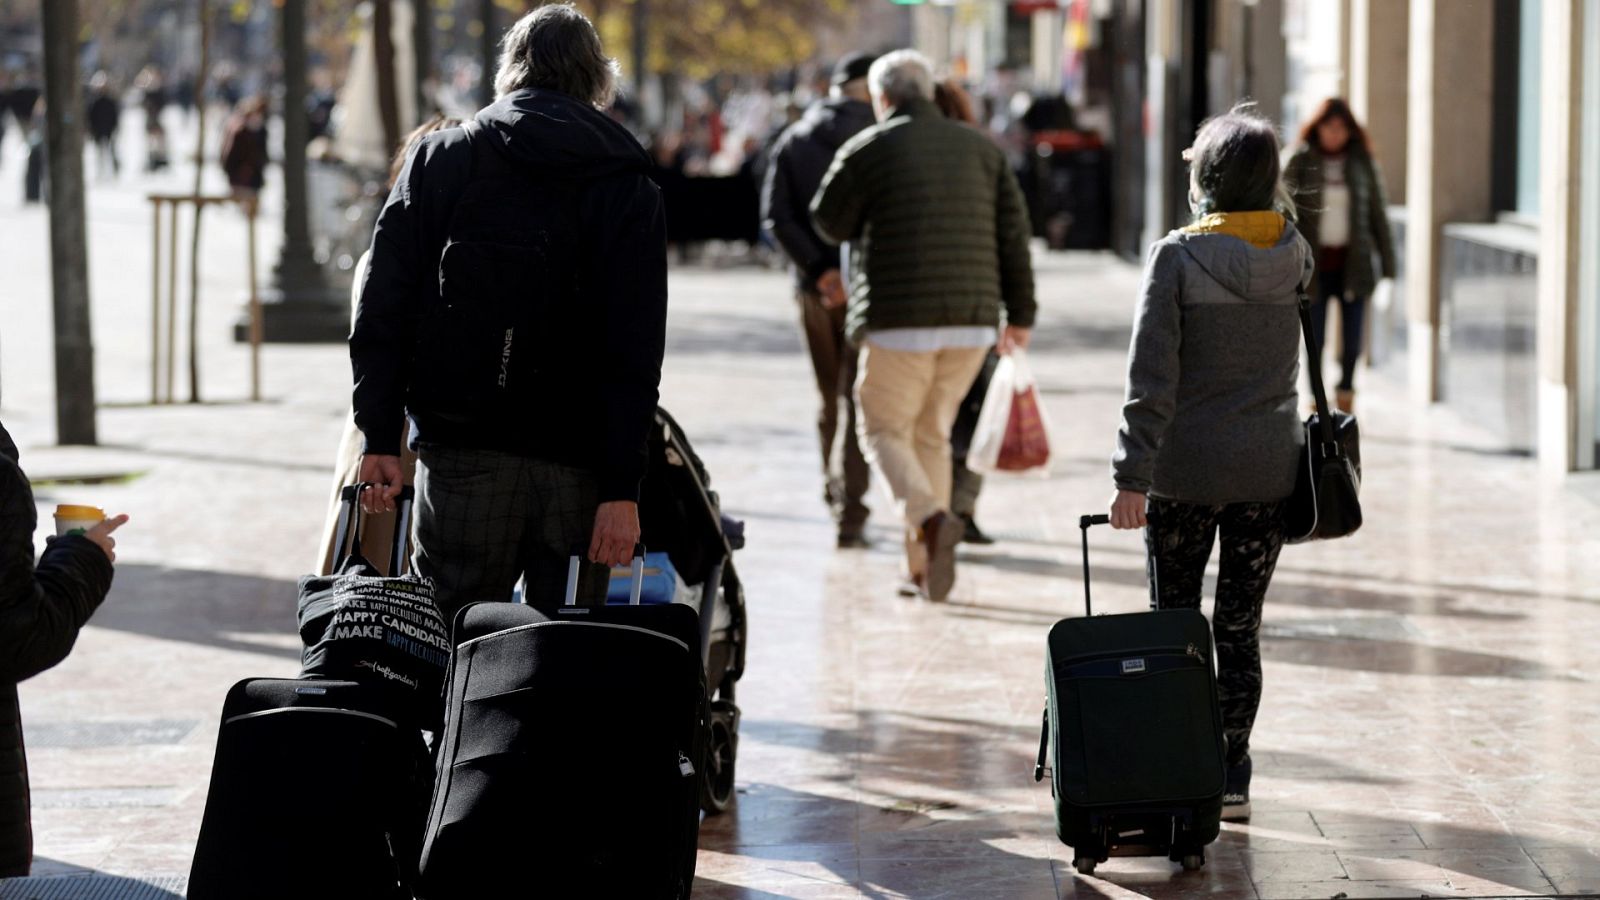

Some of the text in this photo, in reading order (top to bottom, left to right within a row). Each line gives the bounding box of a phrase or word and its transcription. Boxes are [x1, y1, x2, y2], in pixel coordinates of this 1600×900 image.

[356, 587, 383, 595] HAPPY
[385, 589, 432, 606] CANDIDATES
[386, 582, 413, 592] MAKE
[370, 602, 389, 613] HAPPY
[389, 605, 422, 625] RECRUITERS
[389, 597, 413, 609] HAPPY
[335, 611, 452, 653] HAPPY CANDIDATES
[335, 625, 383, 640] MAKE
[386, 630, 408, 653] HAPPY
